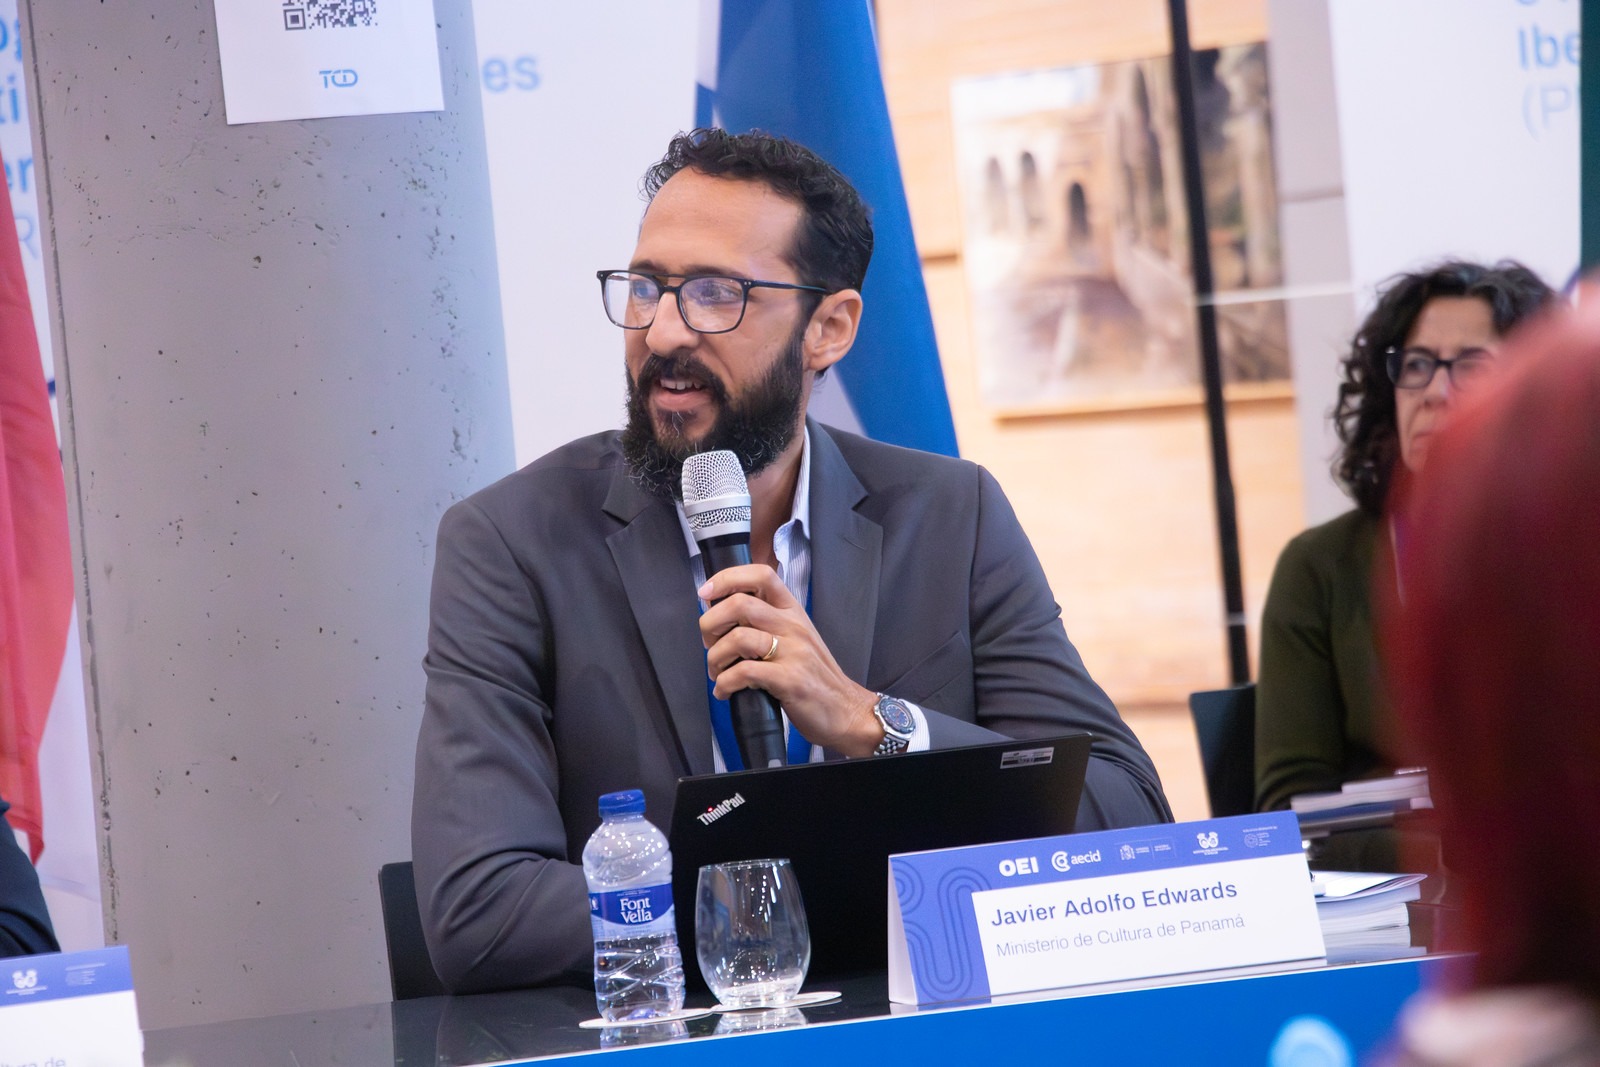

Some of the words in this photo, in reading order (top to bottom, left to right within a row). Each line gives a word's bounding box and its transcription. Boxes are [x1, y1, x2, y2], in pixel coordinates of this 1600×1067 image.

[481, 55, 541, 94] es
[696, 792, 746, 826] ThinkPad
[998, 856, 1040, 877] OEI
[1070, 849, 1102, 865] aecid
[620, 897, 651, 912] Font
[620, 908, 653, 924] Vella
[991, 903, 1056, 927] Javier
[1064, 892, 1136, 918] Adolfo
[1142, 881, 1238, 908] Edwards
[996, 935, 1069, 957] Ministerio
[1073, 932, 1093, 948] de
[1097, 925, 1152, 945] Cultura
[1156, 922, 1177, 938] de
[1180, 913, 1246, 935] Panamá
